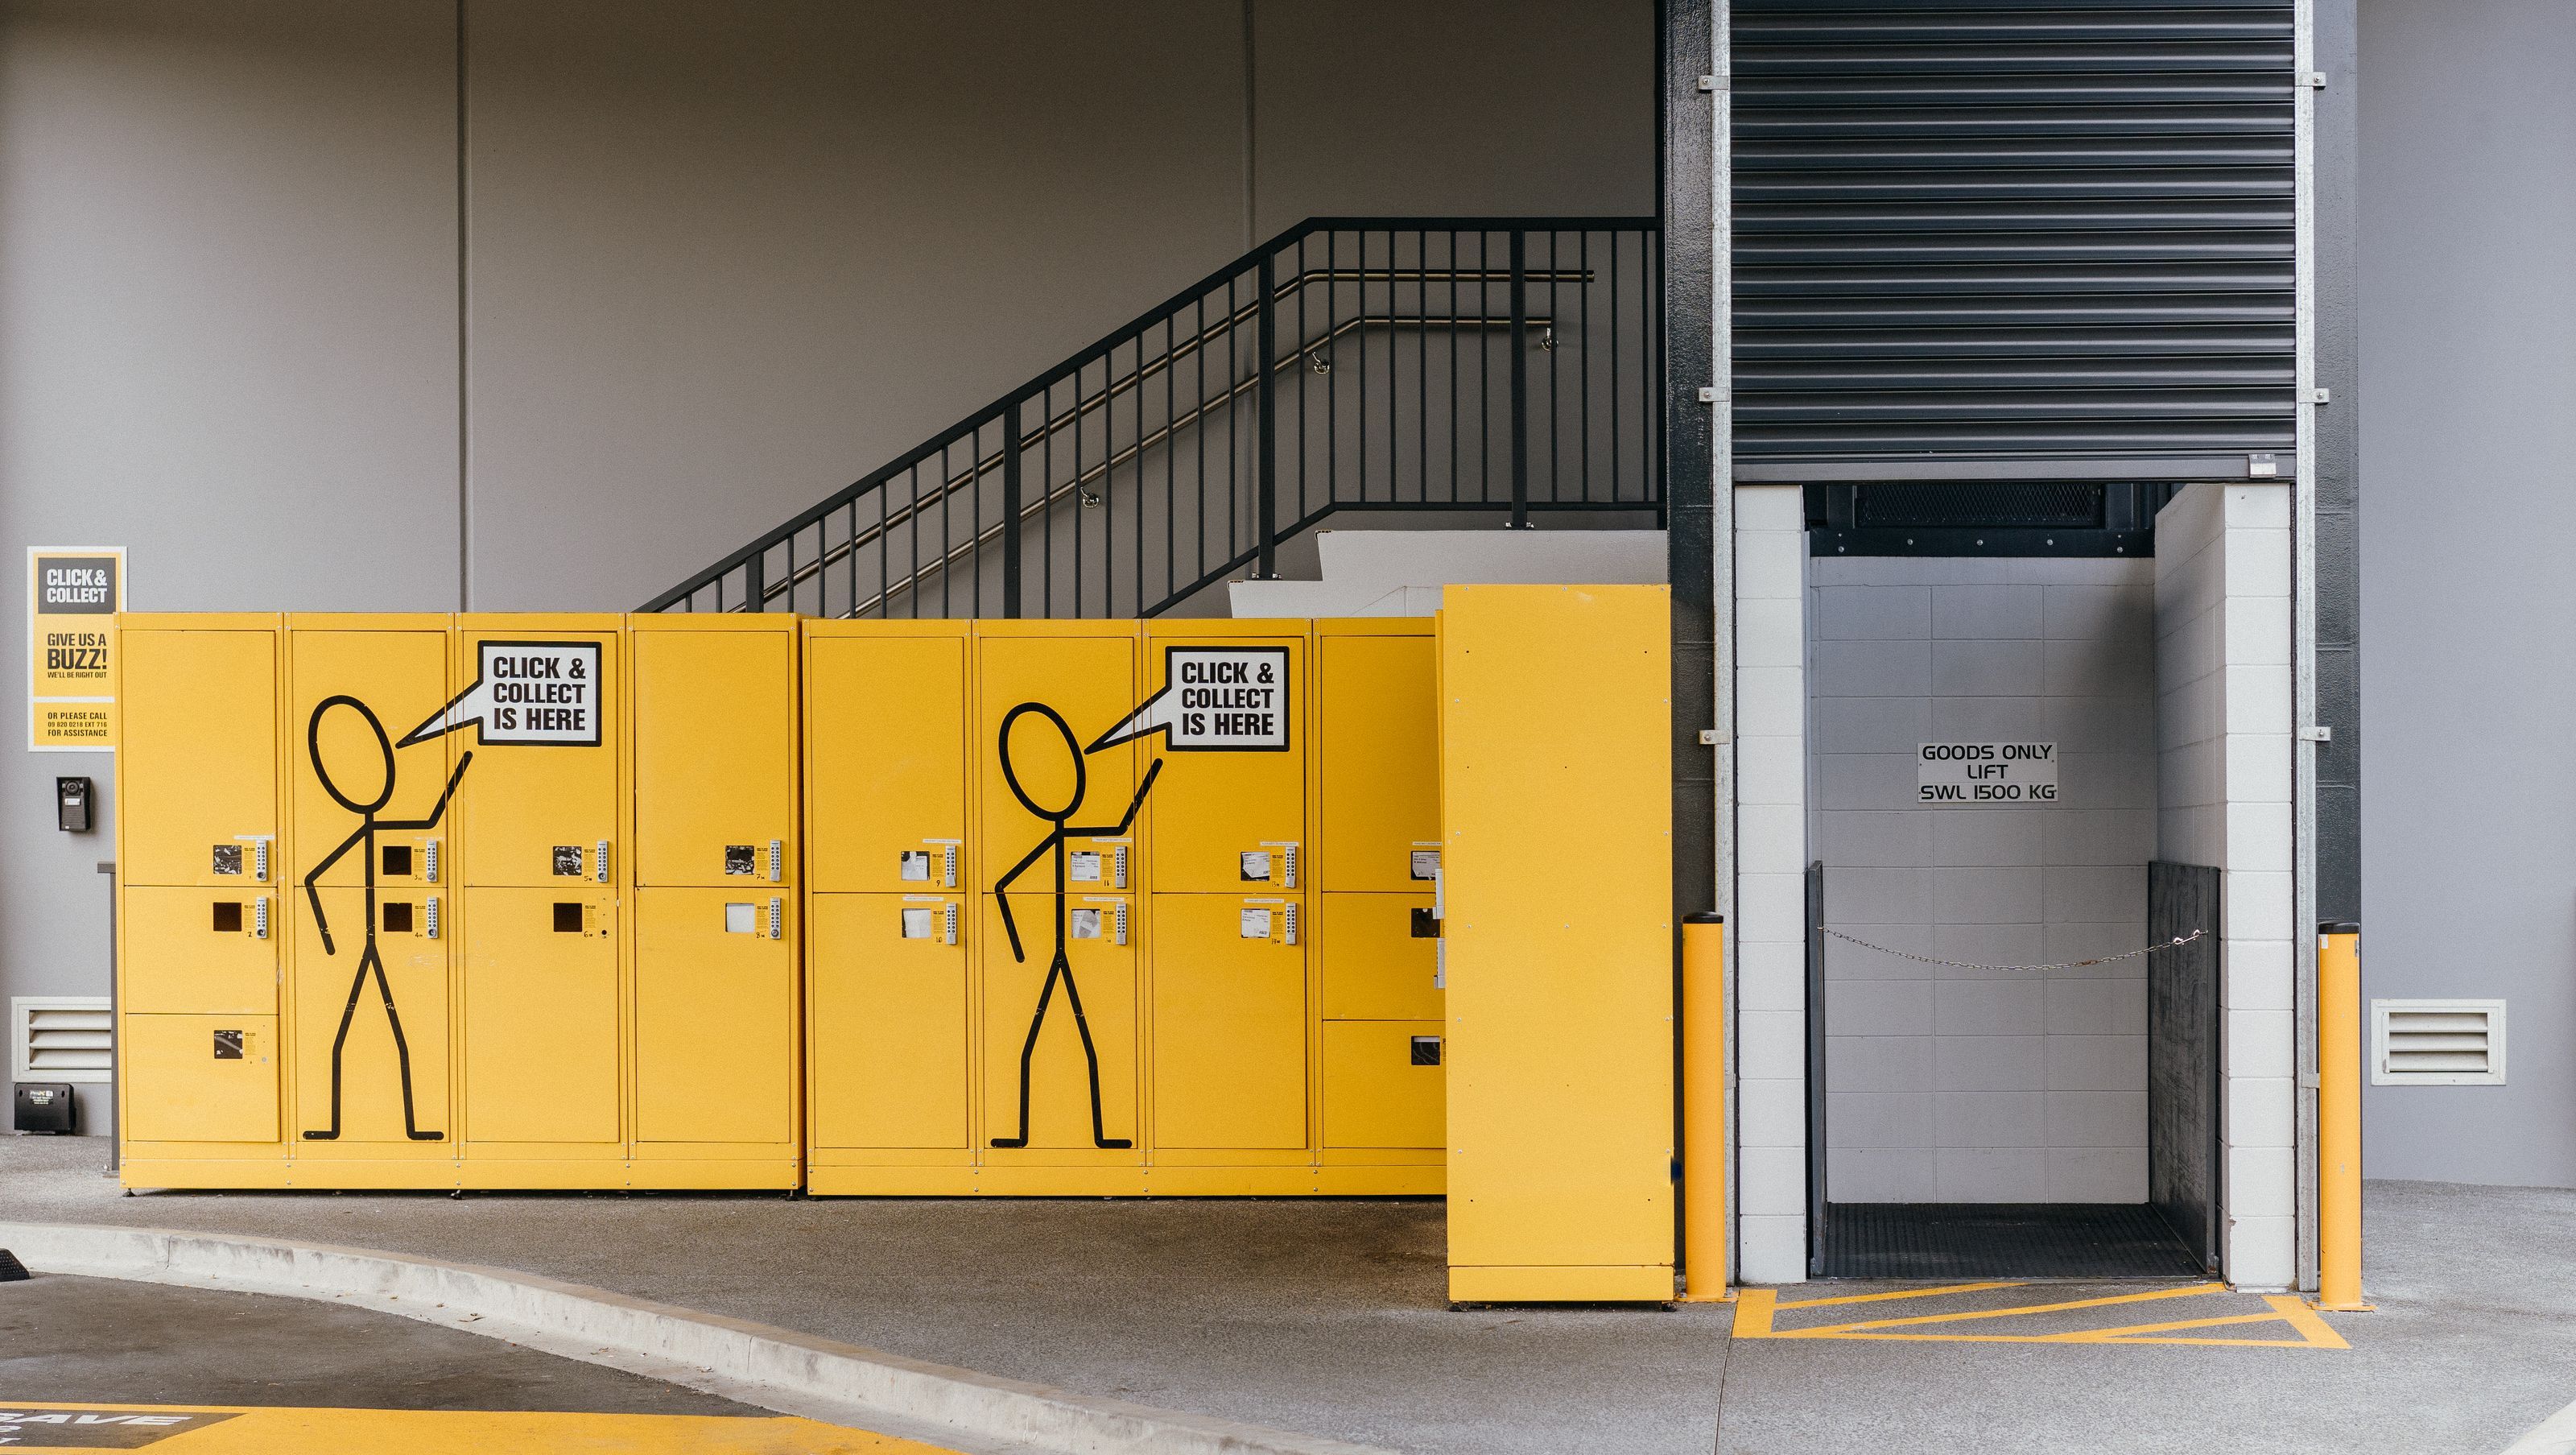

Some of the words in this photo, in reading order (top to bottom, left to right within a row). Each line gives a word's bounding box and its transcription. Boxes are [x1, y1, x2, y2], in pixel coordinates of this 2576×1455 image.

[47, 568, 93, 586] CLICK
[94, 569, 108, 586] &
[47, 587, 108, 603] COLLECT
[47, 633, 75, 646] GIVE
[78, 633, 95, 646] US
[97, 633, 107, 646] A
[47, 648, 107, 669] BUZZ!
[493, 656, 560, 679] CLICK
[568, 658, 586, 679] &
[1182, 662, 1249, 684] CLICK
[1257, 663, 1274, 684] &
[493, 683, 586, 704] COLLECT
[1182, 688, 1274, 709] COLLECT
[47, 712, 58, 720] OR
[60, 712, 88, 720] PLEASE
[89, 712, 108, 720] CALL
[493, 707, 517, 730] IS
[526, 708, 586, 730] HERE
[1183, 713, 1206, 736] IS
[1215, 713, 1274, 736] HERE
[47, 729, 61, 737] FOR
[63, 729, 108, 737] ASSISTANCE
[1922, 745, 1995, 760] GOODS
[2002, 745, 2053, 759] ONLY
[1967, 764, 2008, 779] LIFT
[1921, 785, 1967, 800] SWL
[1974, 784, 2021, 800] 1500
[2029, 784, 2055, 800] KG
